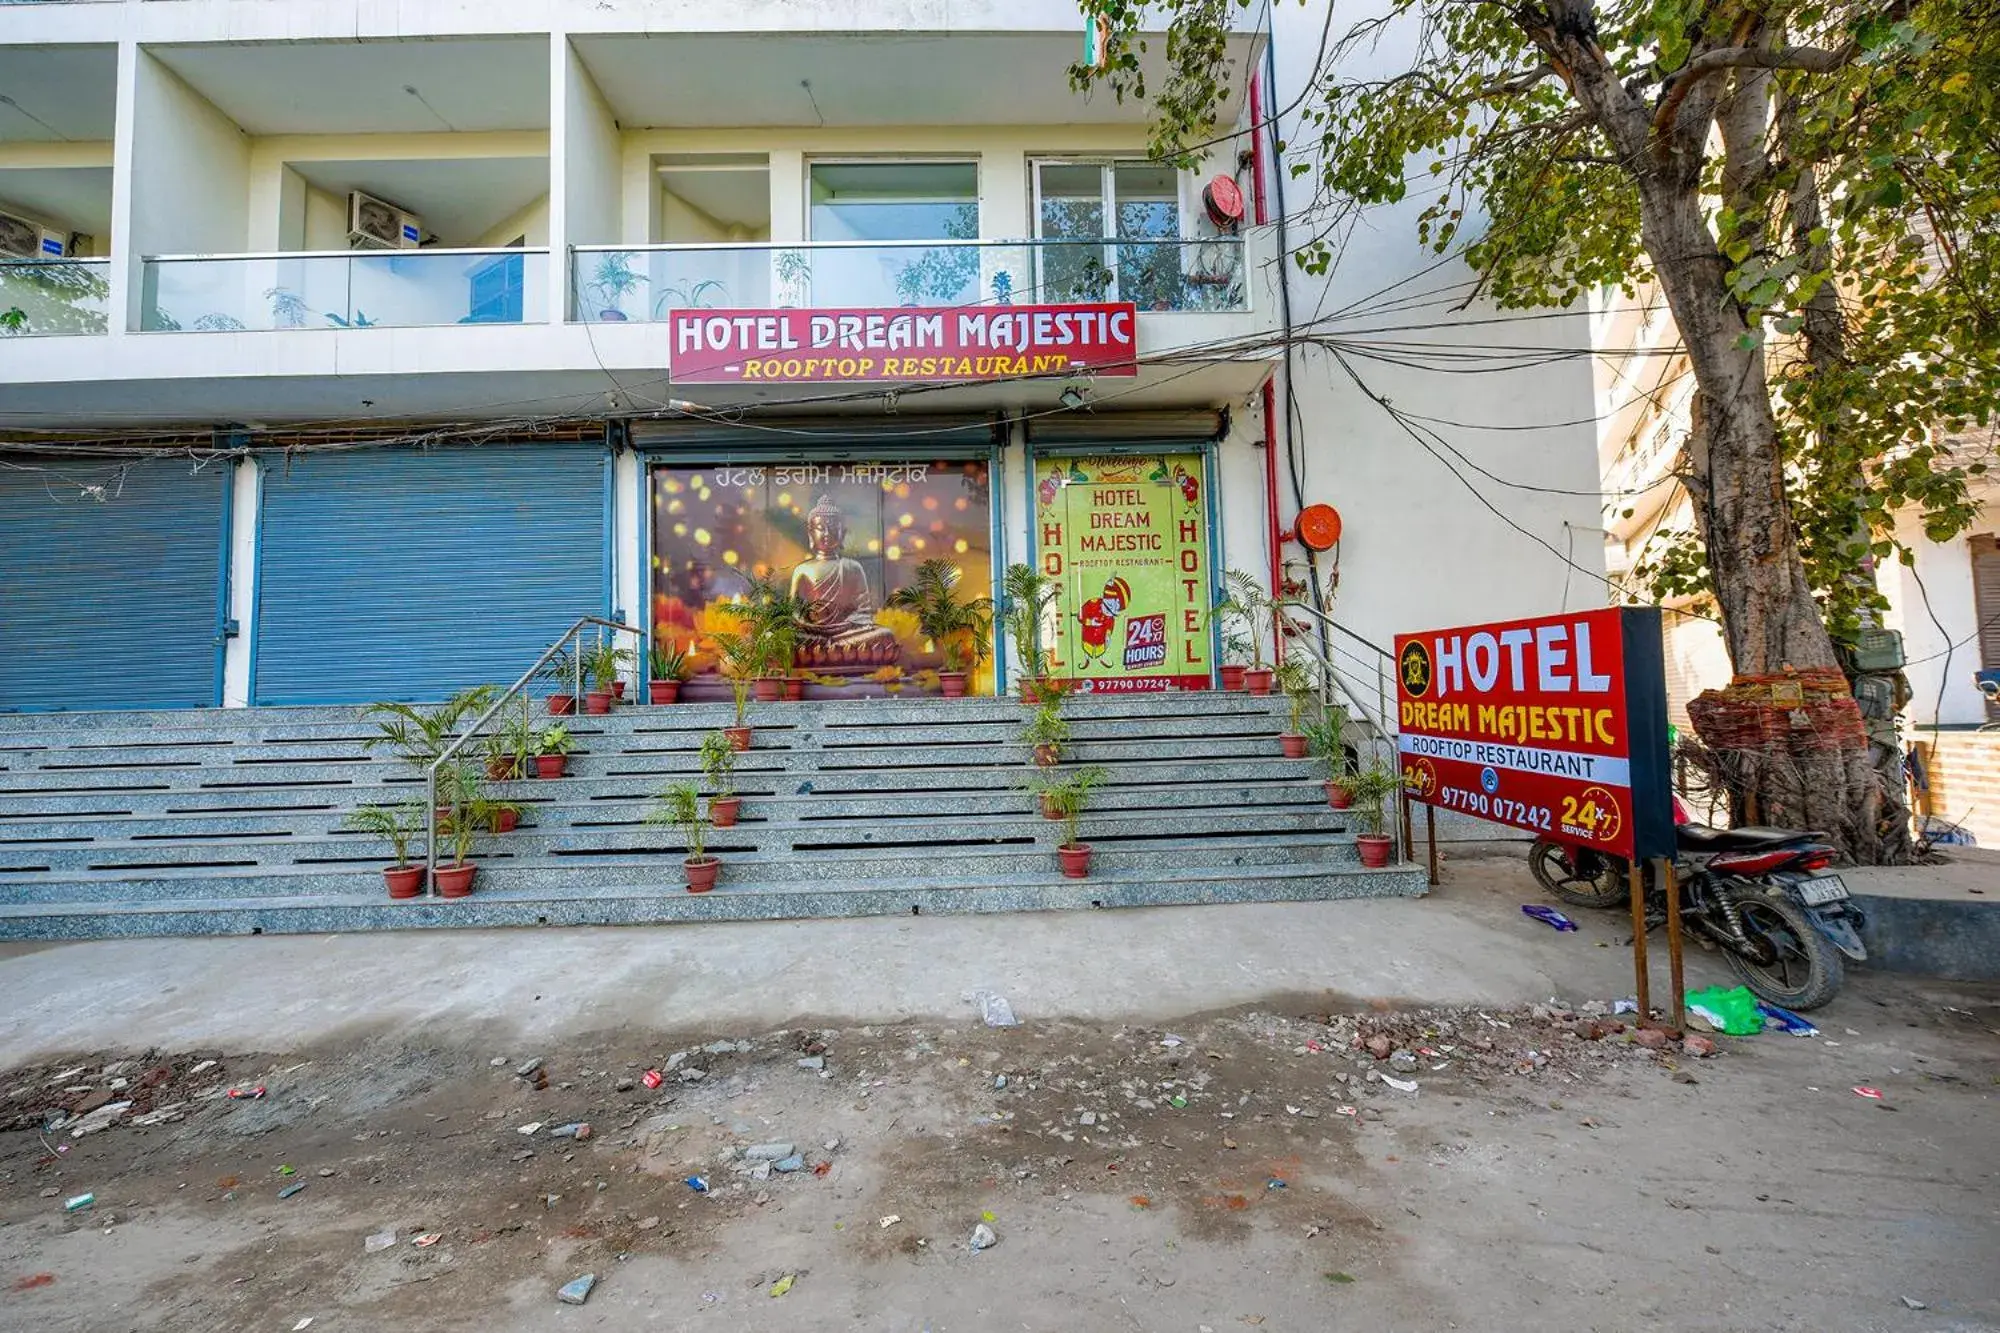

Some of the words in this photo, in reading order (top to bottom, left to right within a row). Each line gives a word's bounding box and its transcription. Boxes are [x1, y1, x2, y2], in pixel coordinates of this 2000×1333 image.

[677, 316, 799, 355] HOTEL
[811, 314, 943, 352] DREAM
[958, 311, 1130, 353] MAJESTIC
[741, 358, 877, 378] ROOFTOP
[881, 355, 1068, 377] RESTAURANT
[1094, 489, 1146, 506] HOTEL
[1091, 512, 1150, 529] DREAM
[1081, 534, 1162, 551] MAJESTIC
[1179, 520, 1202, 663] HOTEL
[1126, 645, 1164, 663] HOURS
[1435, 622, 1611, 698] HOTEL
[1098, 680, 1133, 689] 97790
[1402, 701, 1470, 733] DREAM
[1478, 704, 1615, 745] MAJESTIC
[1412, 736, 1472, 759] ROOFTOP
[1477, 744, 1594, 778] RESTAURANT
[1441, 785, 1488, 815] 97790
[1494, 797, 1552, 831] 07242
[1561, 824, 1594, 839] SERVICE
